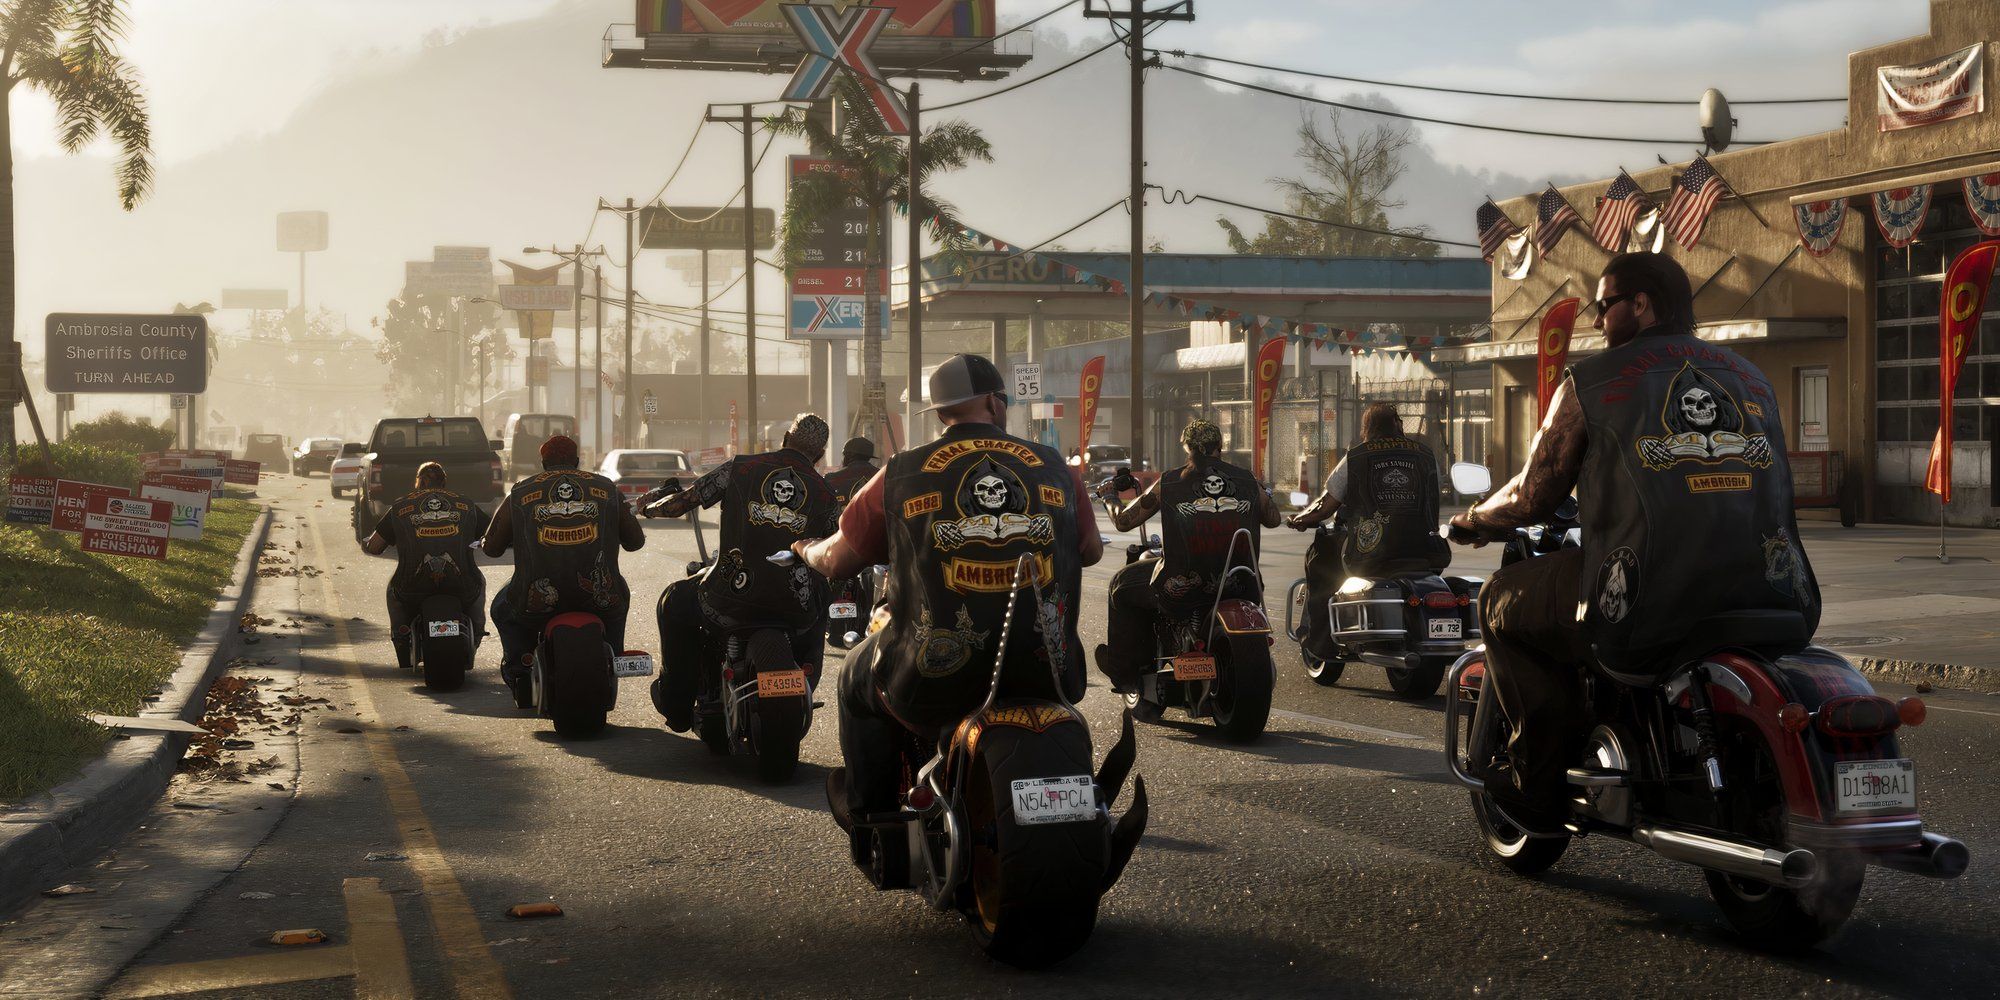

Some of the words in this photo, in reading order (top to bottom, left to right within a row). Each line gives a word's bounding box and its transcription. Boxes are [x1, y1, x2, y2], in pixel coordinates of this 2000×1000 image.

[807, 296, 866, 332] XER
[55, 322, 133, 336] Ambrosia
[140, 323, 198, 340] County
[66, 346, 132, 359] Sheriffs
[140, 346, 187, 360] Office
[75, 372, 114, 383] TURN
[122, 372, 175, 384] AHEAD
[1018, 382, 1038, 395] 35
[928, 442, 970, 470] FINAL
[972, 438, 1037, 467] CHAPTER
[1692, 476, 1748, 490] AMBROSIA
[1043, 488, 1062, 503] MC
[61, 510, 82, 519] FOR
[90, 514, 103, 522] THE
[104, 517, 128, 525] SWEET
[129, 520, 167, 530] LIFEBLOOD
[115, 524, 151, 534] AMBROSIA
[420, 526, 455, 535] AMBROSIA
[544, 526, 592, 542] AMBROSIA
[101, 532, 125, 541] VOTE
[127, 534, 149, 544] ERIN
[89, 538, 160, 556] HENSHAW
[1447, 624, 1460, 633] 732
